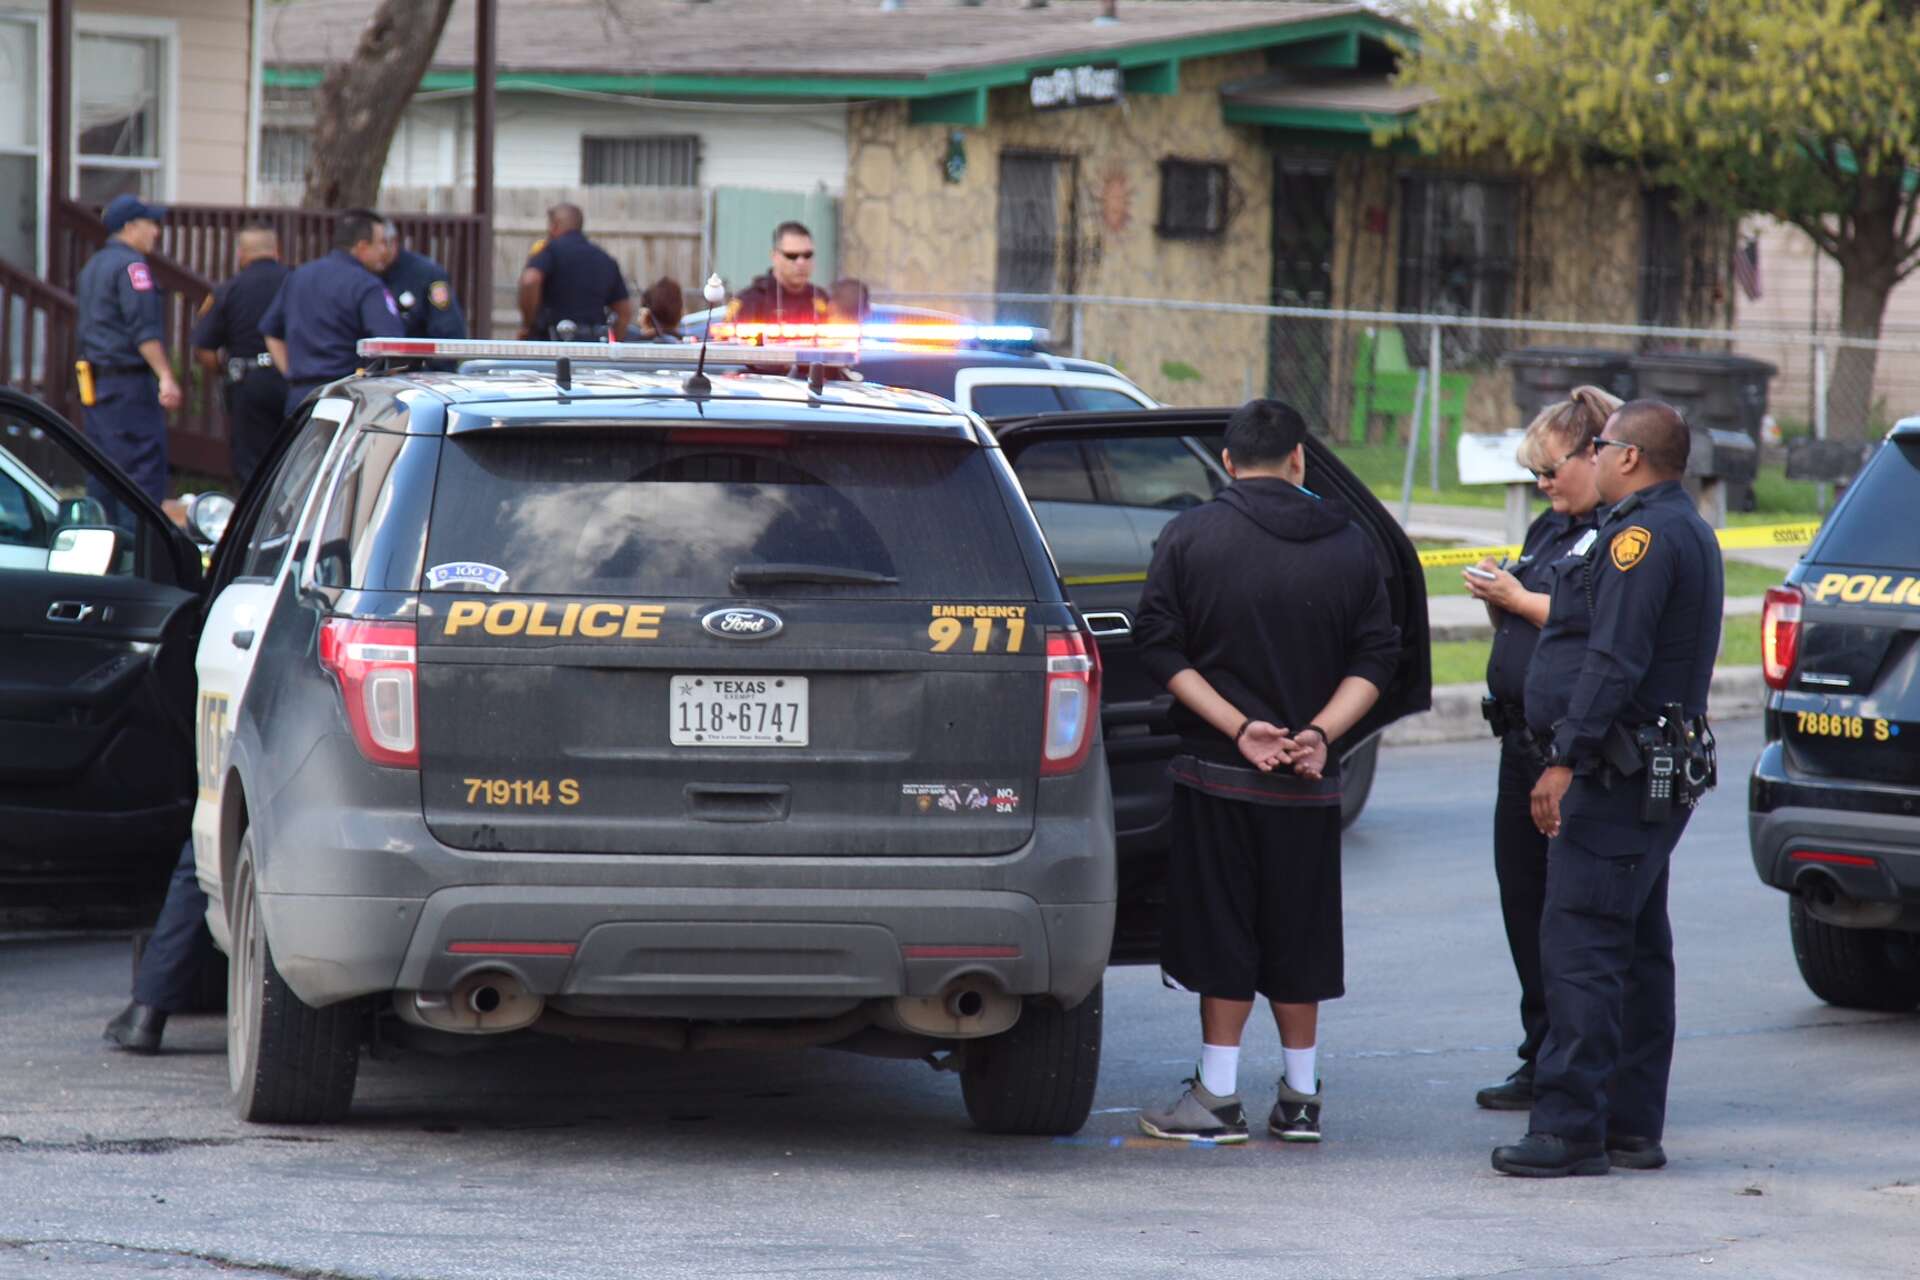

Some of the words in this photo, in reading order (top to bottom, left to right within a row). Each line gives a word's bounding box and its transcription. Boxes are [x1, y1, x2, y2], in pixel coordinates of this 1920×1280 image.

[456, 566, 483, 576] 100
[443, 601, 665, 638] POLICE
[931, 605, 1026, 617] EMERGENCY
[721, 612, 765, 632] Ford
[928, 617, 1025, 653] 911
[713, 681, 766, 693] TEXAS
[1797, 711, 1863, 738] 788616
[1874, 718, 1889, 740] S
[463, 779, 551, 805] 719114
[558, 779, 580, 805] S
[996, 788, 1014, 799] NO
